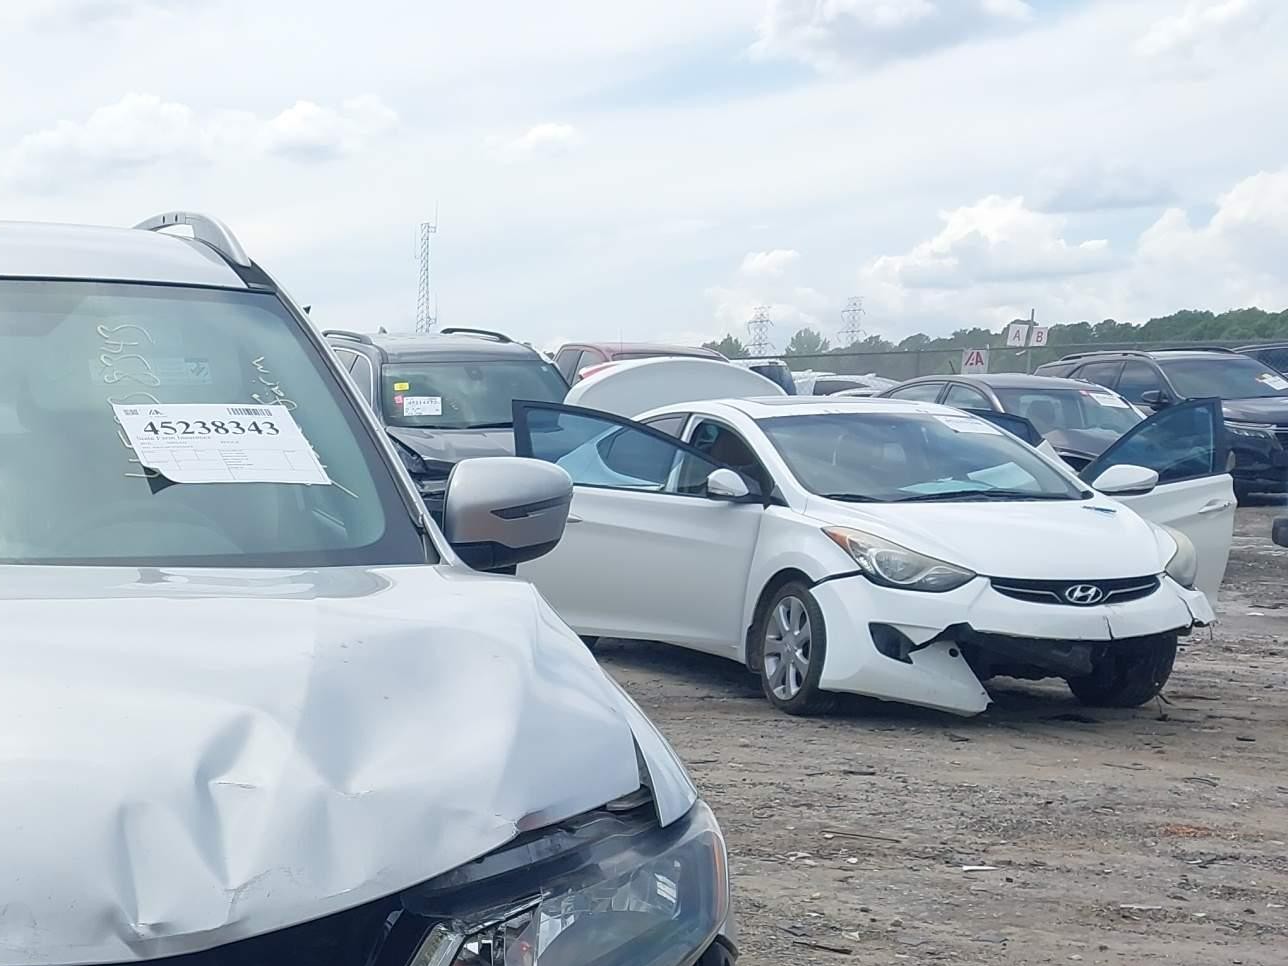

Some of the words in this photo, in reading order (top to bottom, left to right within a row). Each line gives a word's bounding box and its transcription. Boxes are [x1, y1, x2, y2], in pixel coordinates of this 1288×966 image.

[1012, 329, 1021, 342] A
[1035, 331, 1044, 343] B
[143, 420, 280, 436] 45238343
